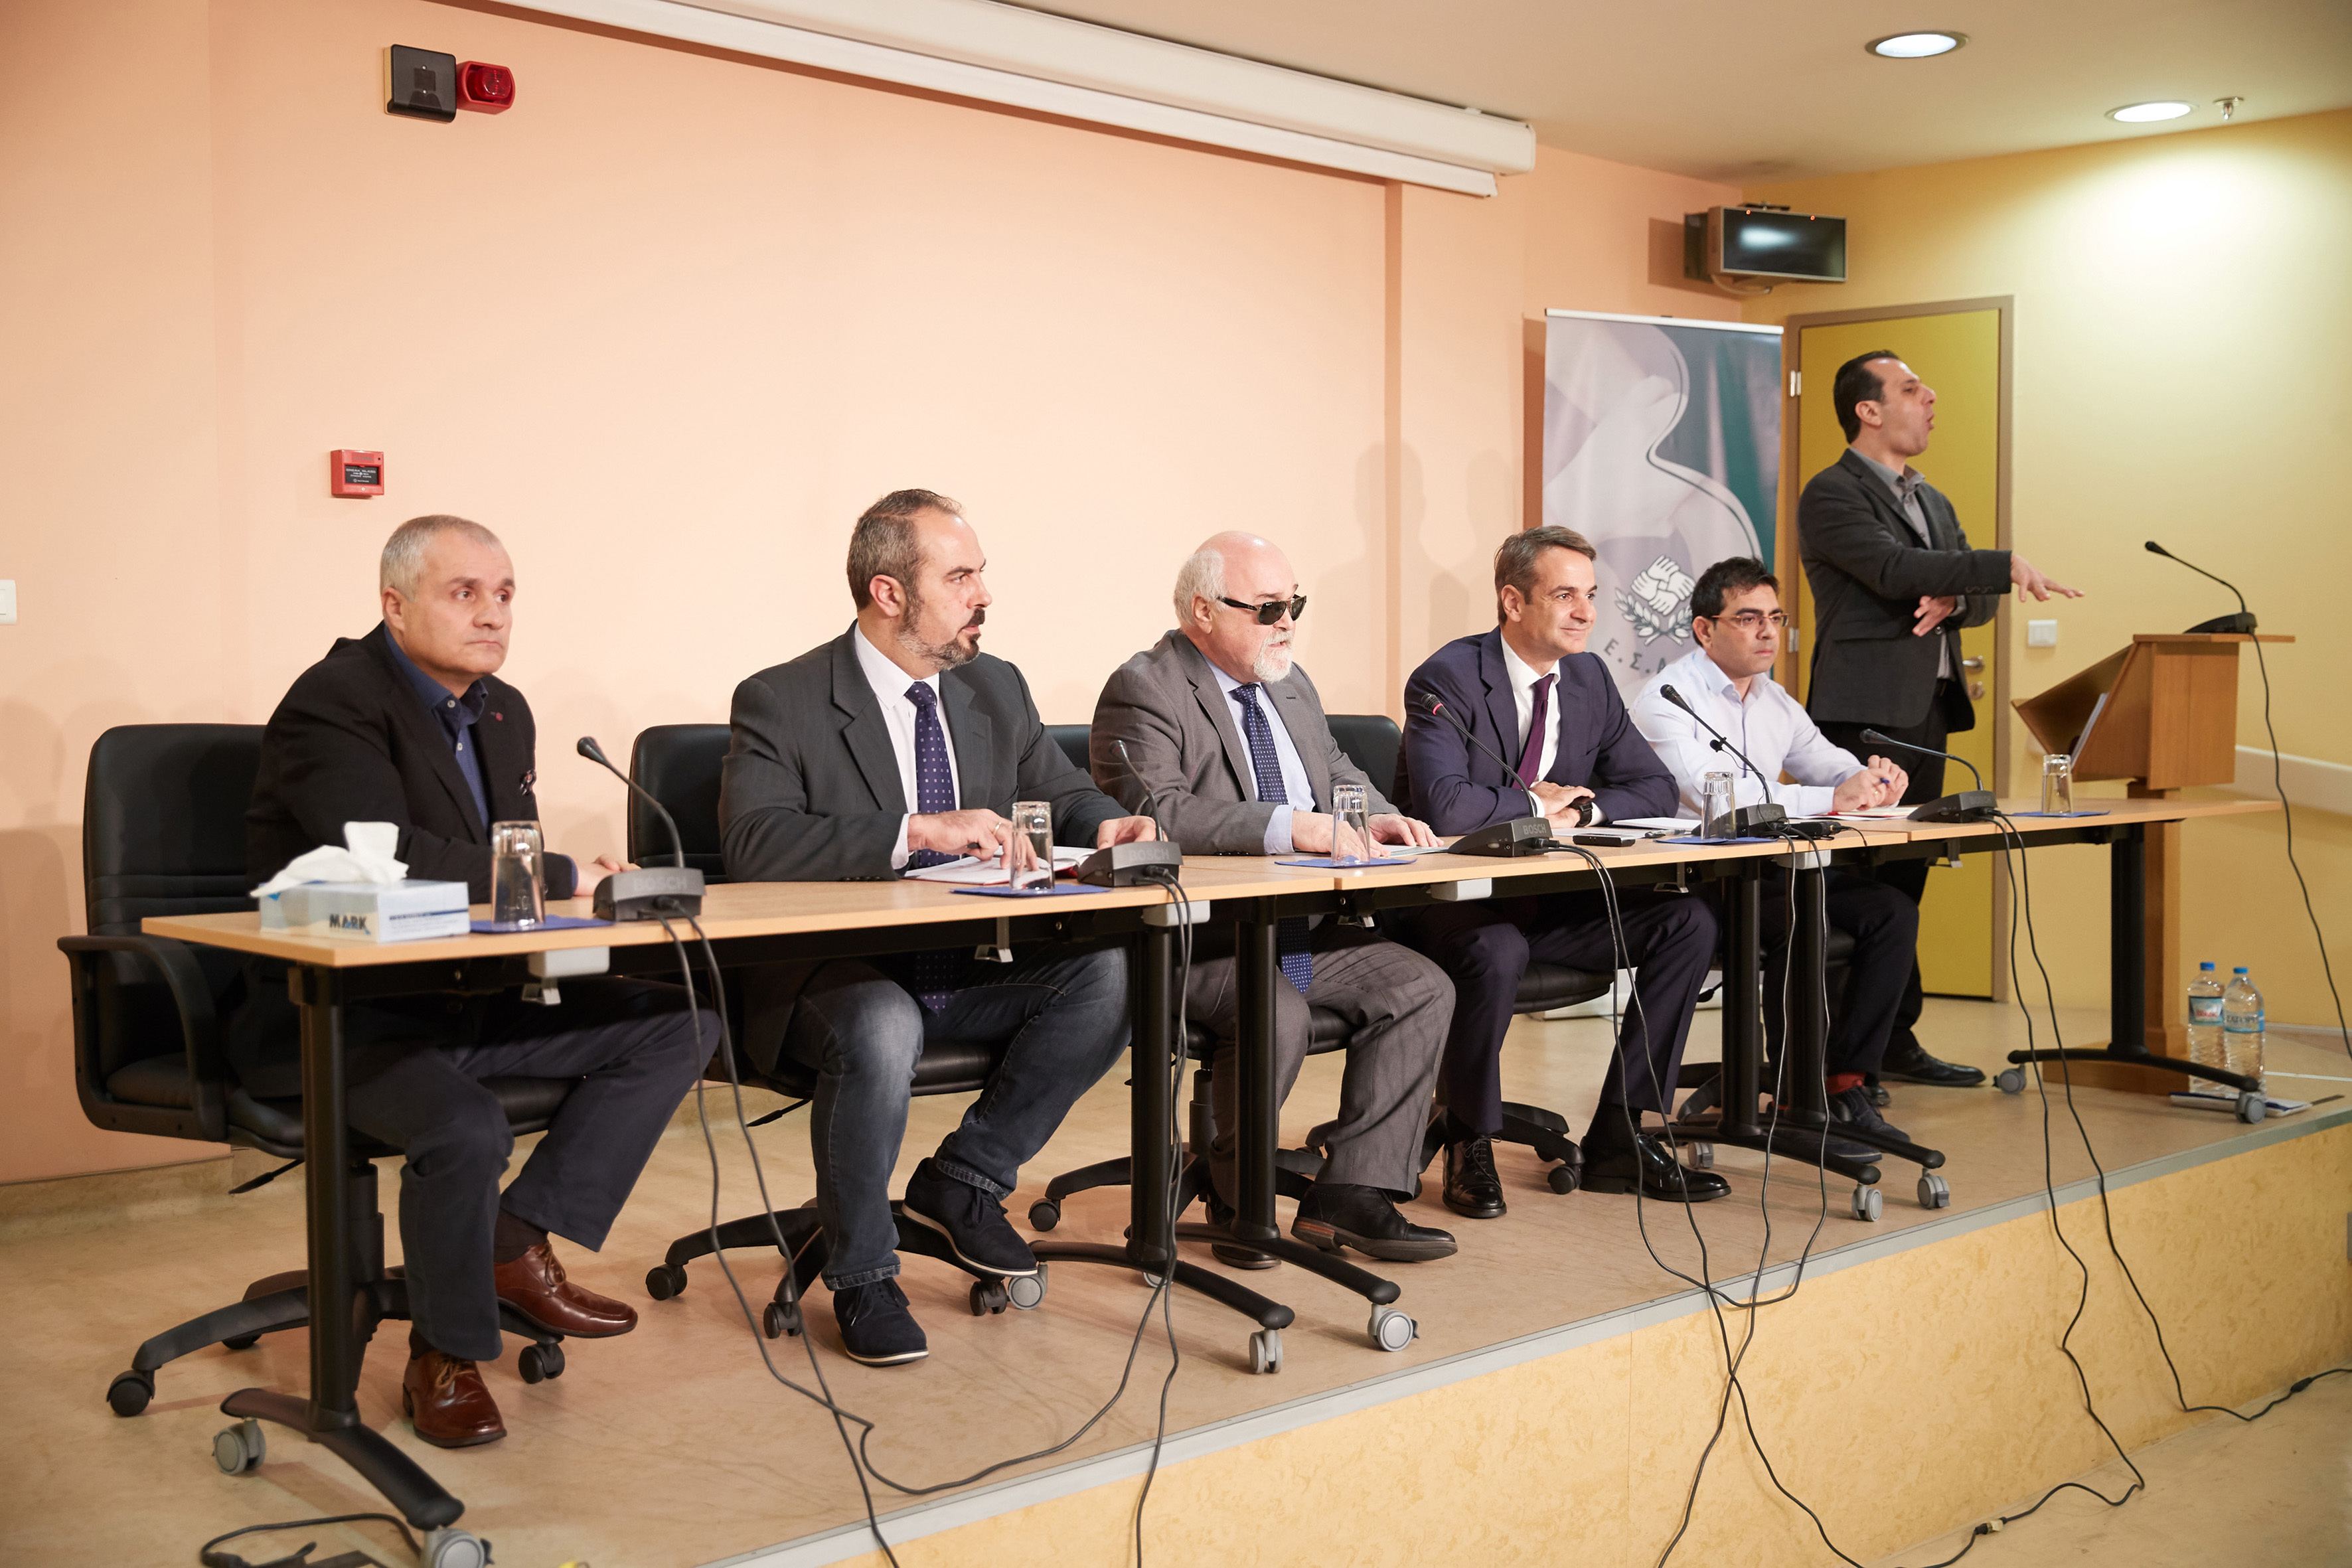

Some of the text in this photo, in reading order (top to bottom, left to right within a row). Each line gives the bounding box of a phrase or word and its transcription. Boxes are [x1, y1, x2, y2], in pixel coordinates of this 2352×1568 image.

[1522, 823, 1547, 835] BOSCH
[1129, 849, 1170, 862] BOSCH
[633, 876, 687, 891] BOSCH
[329, 913, 367, 930] MARK
